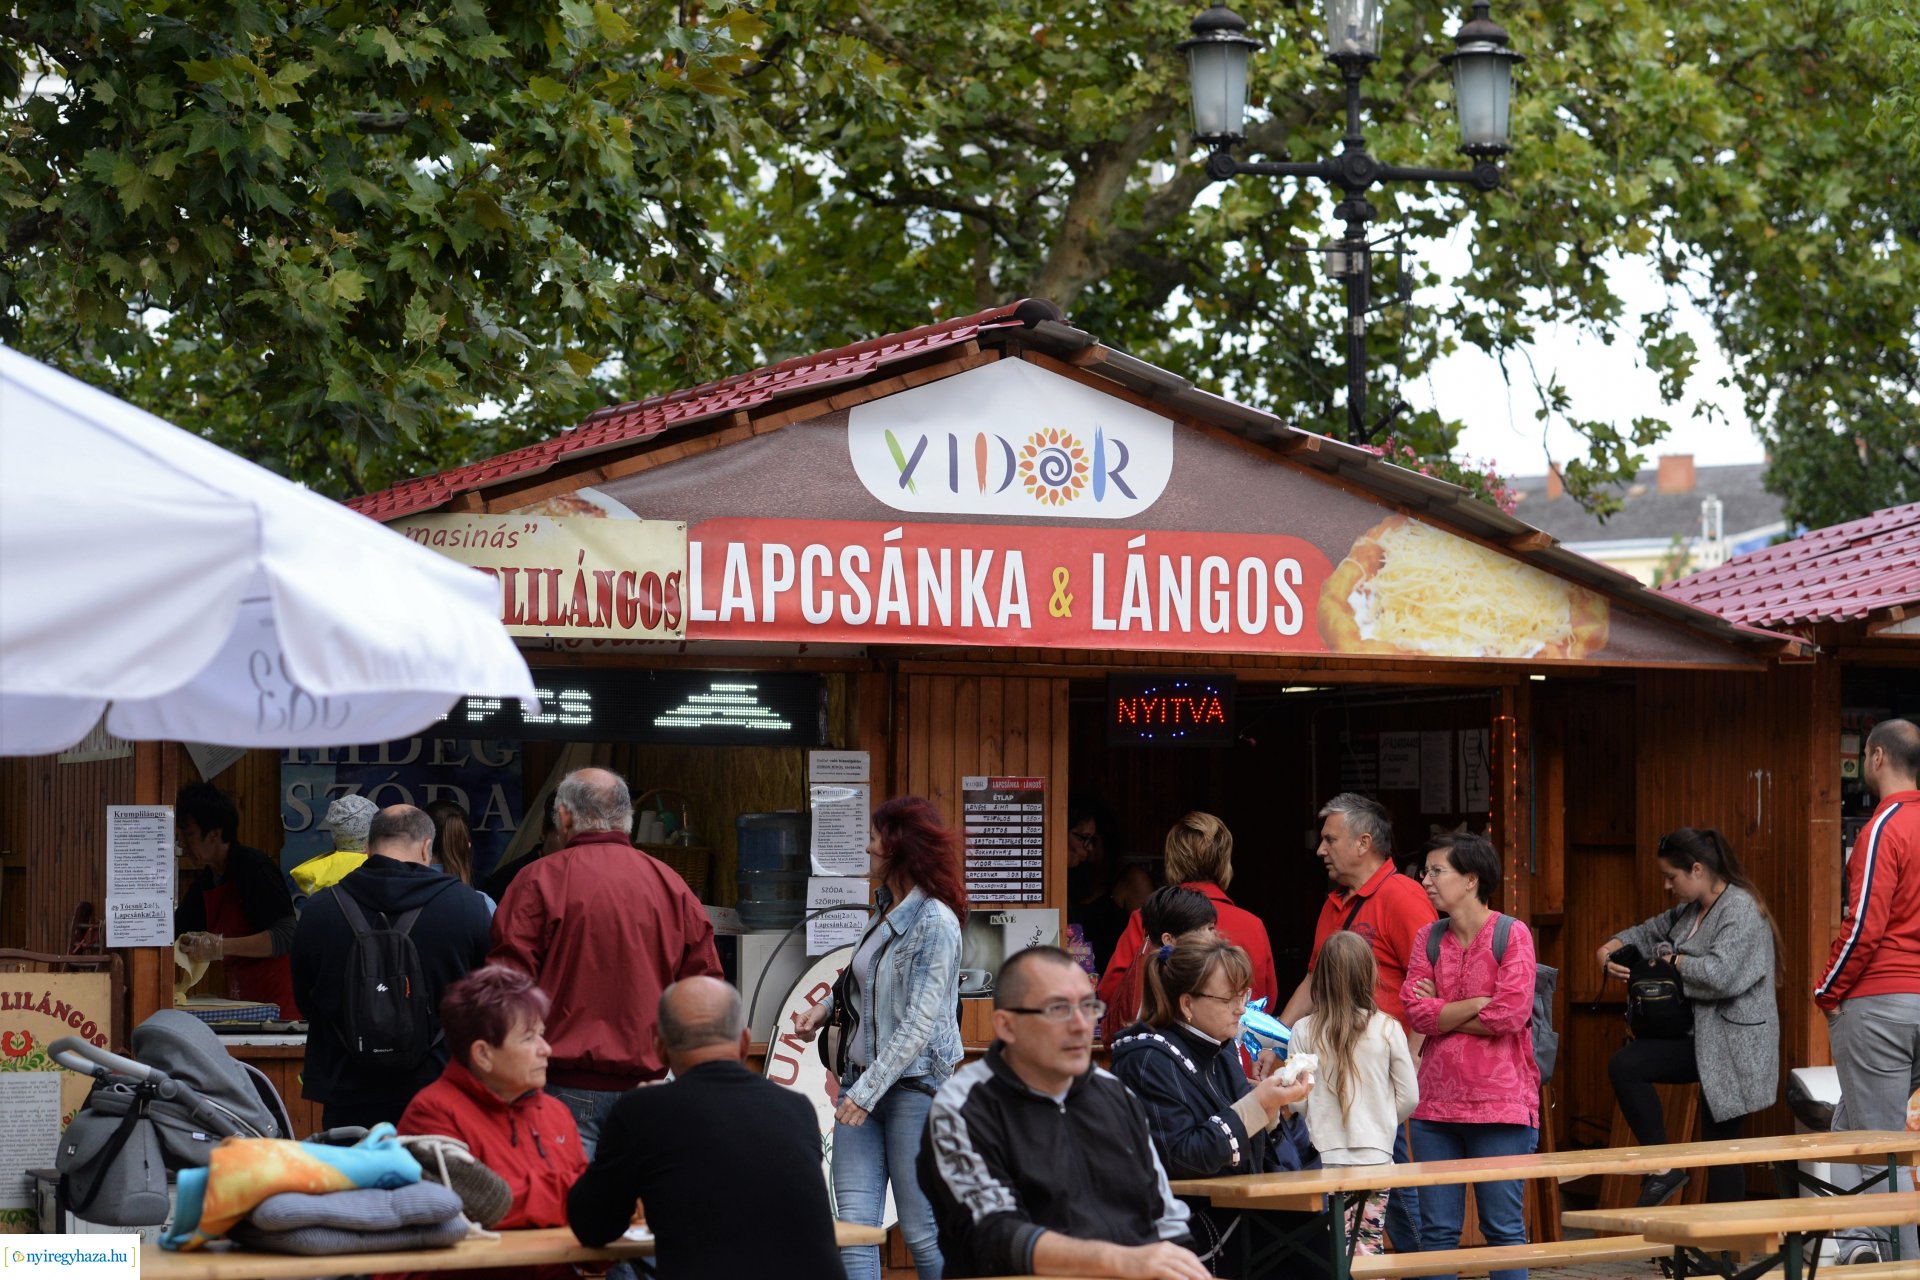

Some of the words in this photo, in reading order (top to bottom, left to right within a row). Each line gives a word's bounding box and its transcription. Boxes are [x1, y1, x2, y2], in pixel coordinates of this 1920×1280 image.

[884, 422, 1138, 506] VIDOR
[472, 549, 682, 632] LILÁNGOS
[689, 526, 1032, 629] LAPCSÁNKA
[1048, 566, 1074, 618] &
[1091, 533, 1304, 636] LÁNGOS
[1118, 697, 1225, 723] NYITVA
[993, 793, 1014, 801] ÉTLAP
[114, 810, 167, 819] Krumplilángos
[821, 886, 844, 894] SZÓDA
[990, 913, 1017, 925] KÁVÉ
